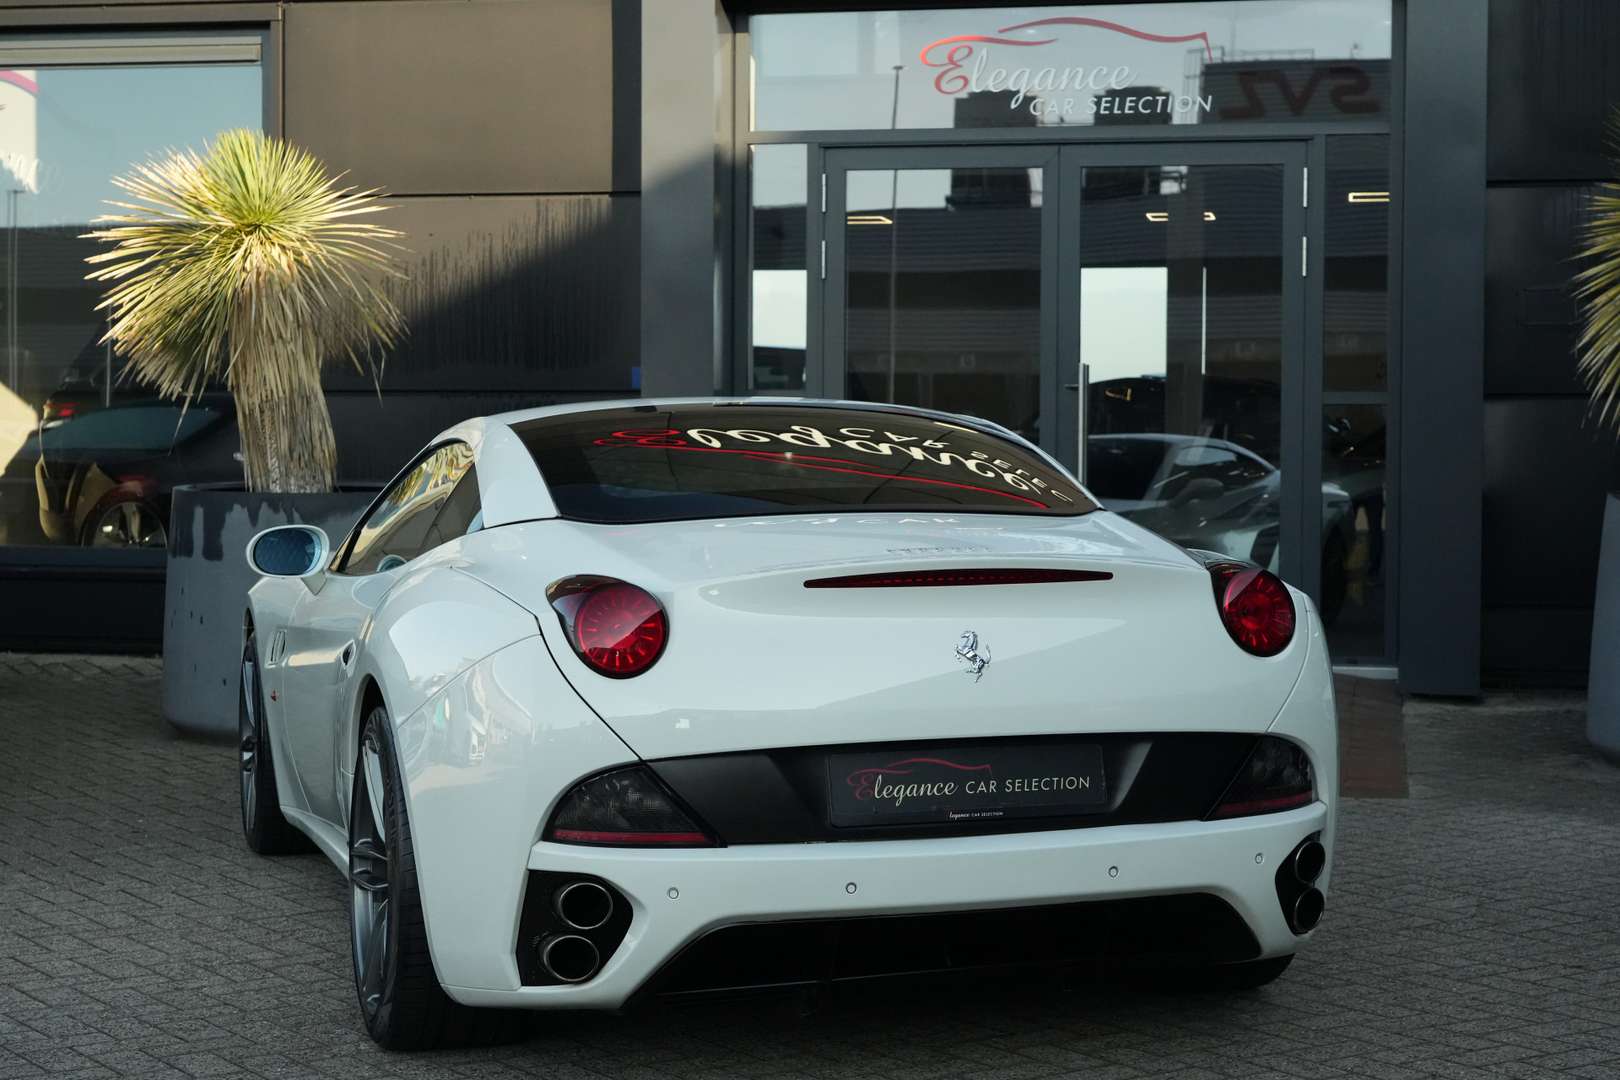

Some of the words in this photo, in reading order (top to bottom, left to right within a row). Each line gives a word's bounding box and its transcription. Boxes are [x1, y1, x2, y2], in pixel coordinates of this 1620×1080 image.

[920, 38, 1136, 108] Elegance
[1029, 98, 1073, 115] CAR
[1087, 95, 1212, 115] SELECTION
[847, 770, 959, 806] Elegance
[965, 779, 998, 794] CAR
[1004, 775, 1090, 793] SELECTION
